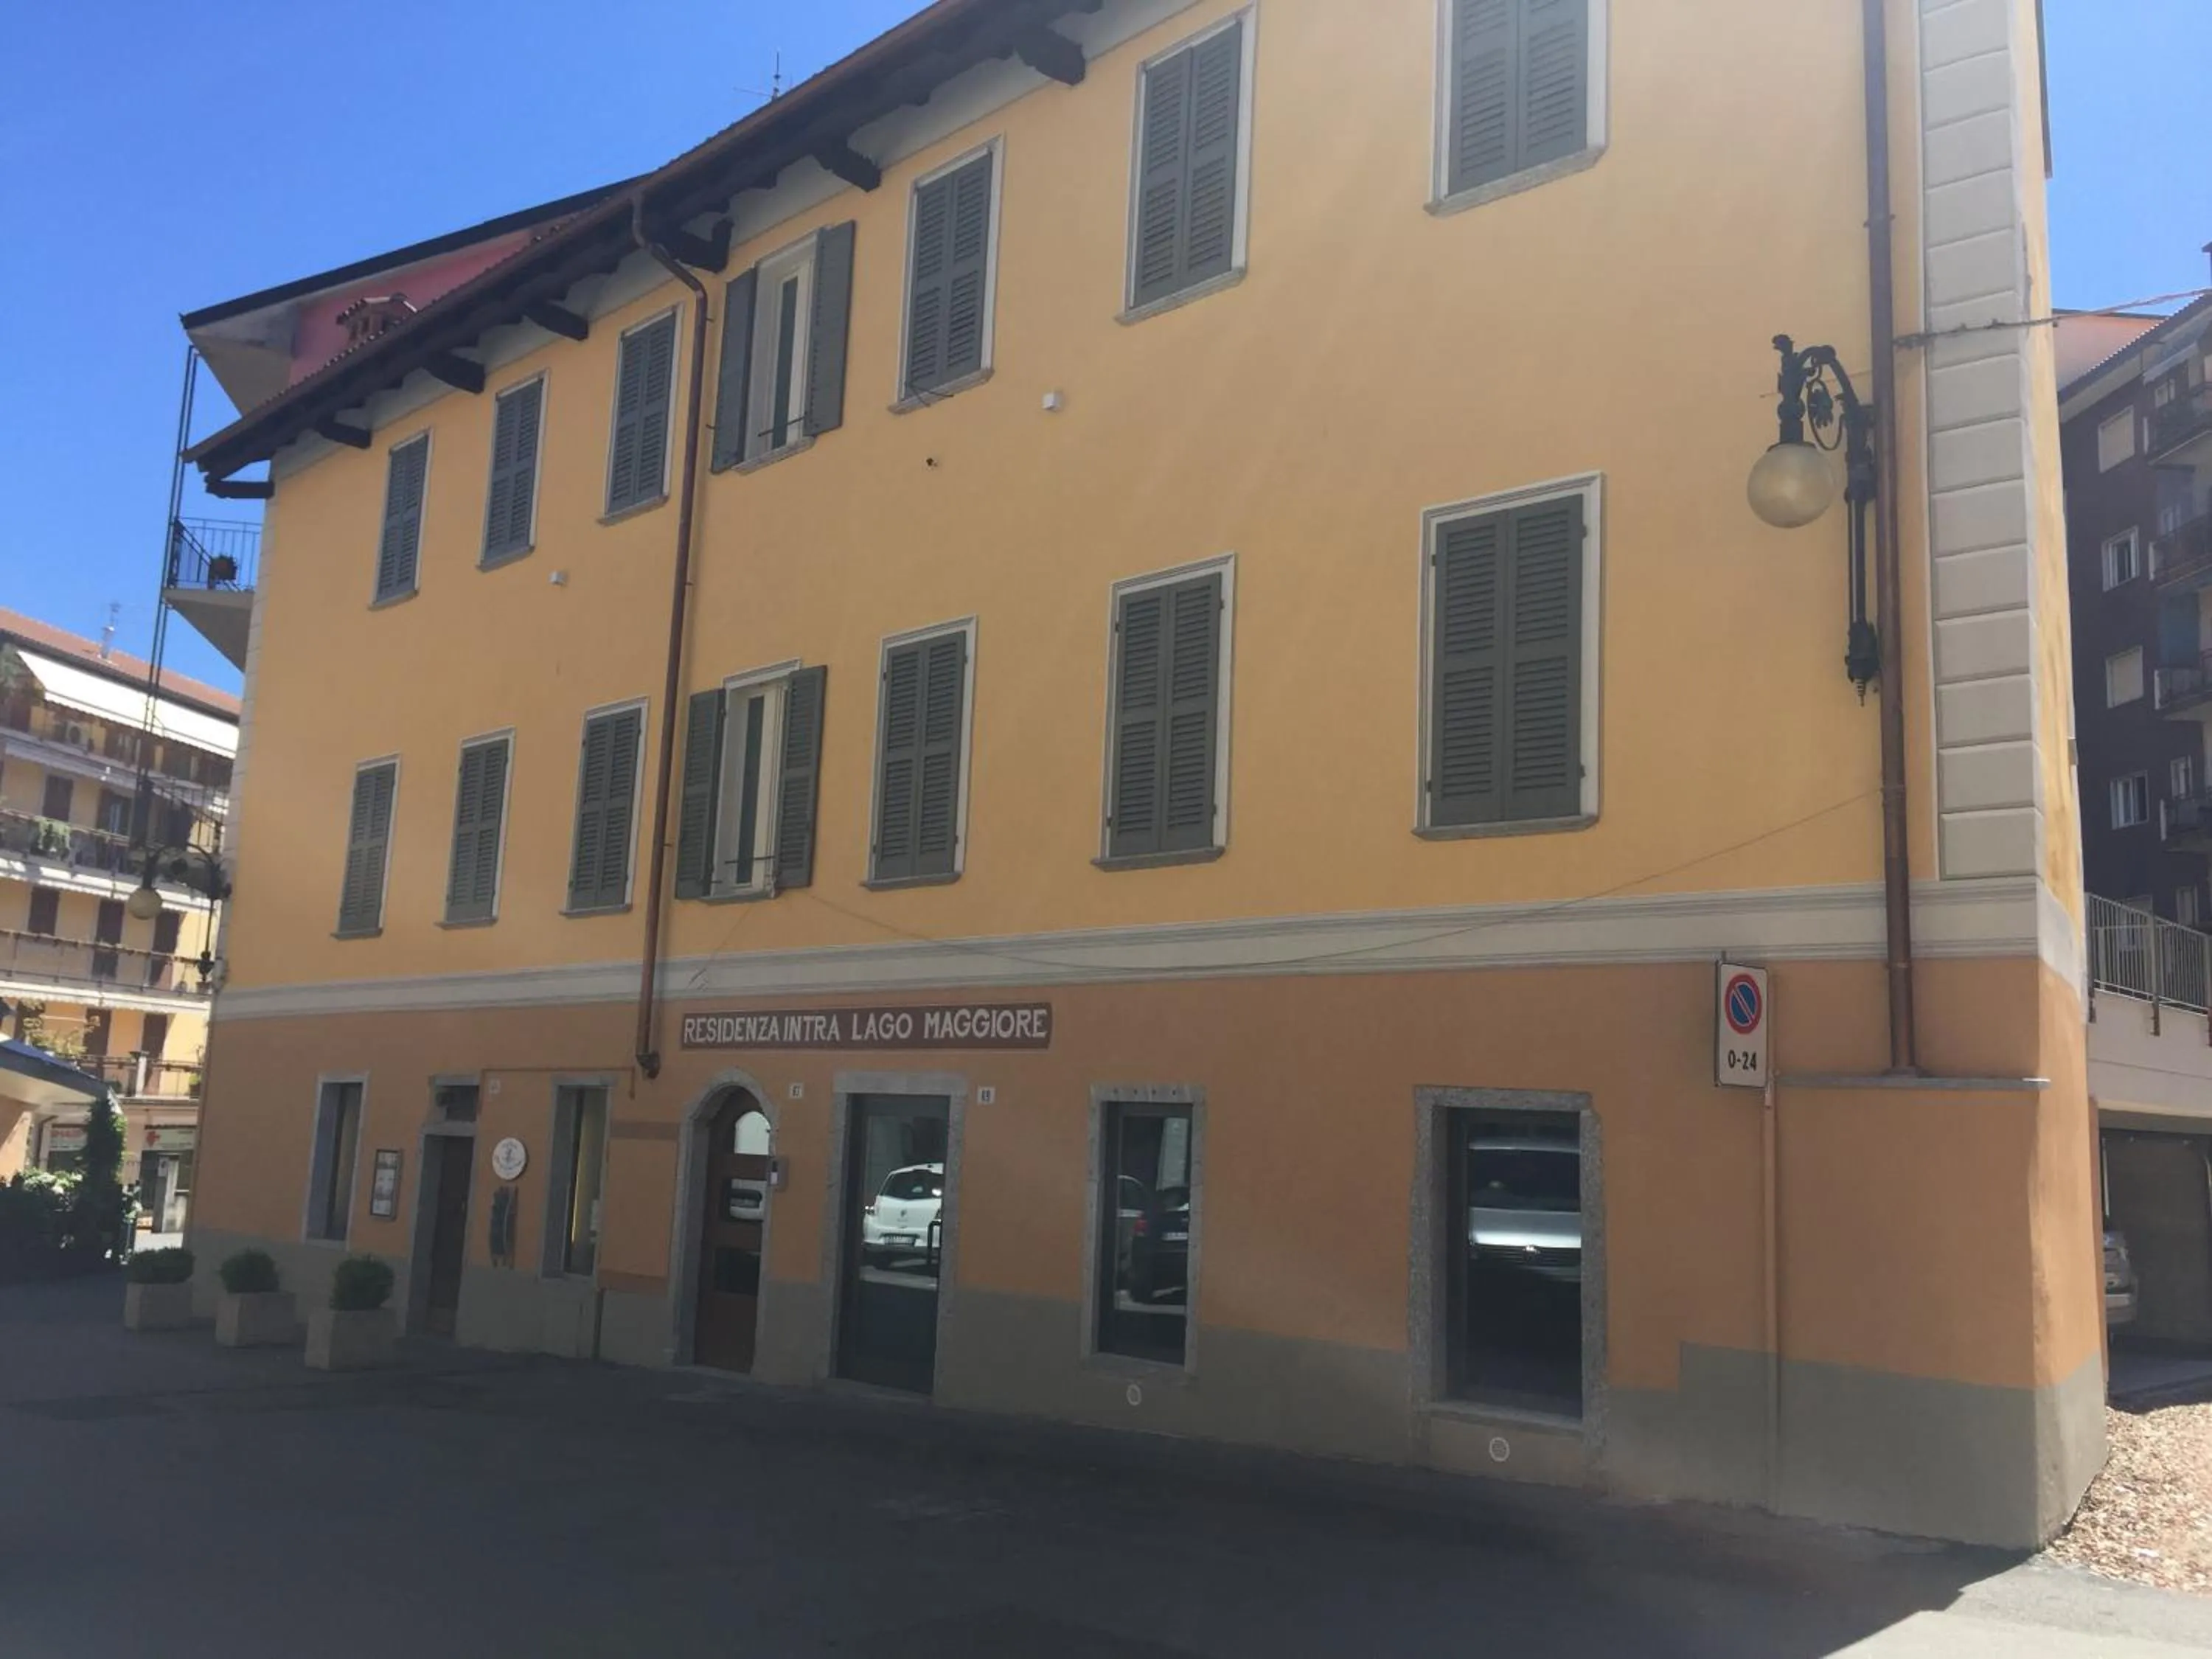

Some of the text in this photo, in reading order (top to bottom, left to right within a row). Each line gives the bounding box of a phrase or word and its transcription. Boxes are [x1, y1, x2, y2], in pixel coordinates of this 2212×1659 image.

[684, 1009, 1048, 1043] RESIDENZA INTRA LAGO MAGGIORE
[1728, 1049, 1757, 1071] 0-24
